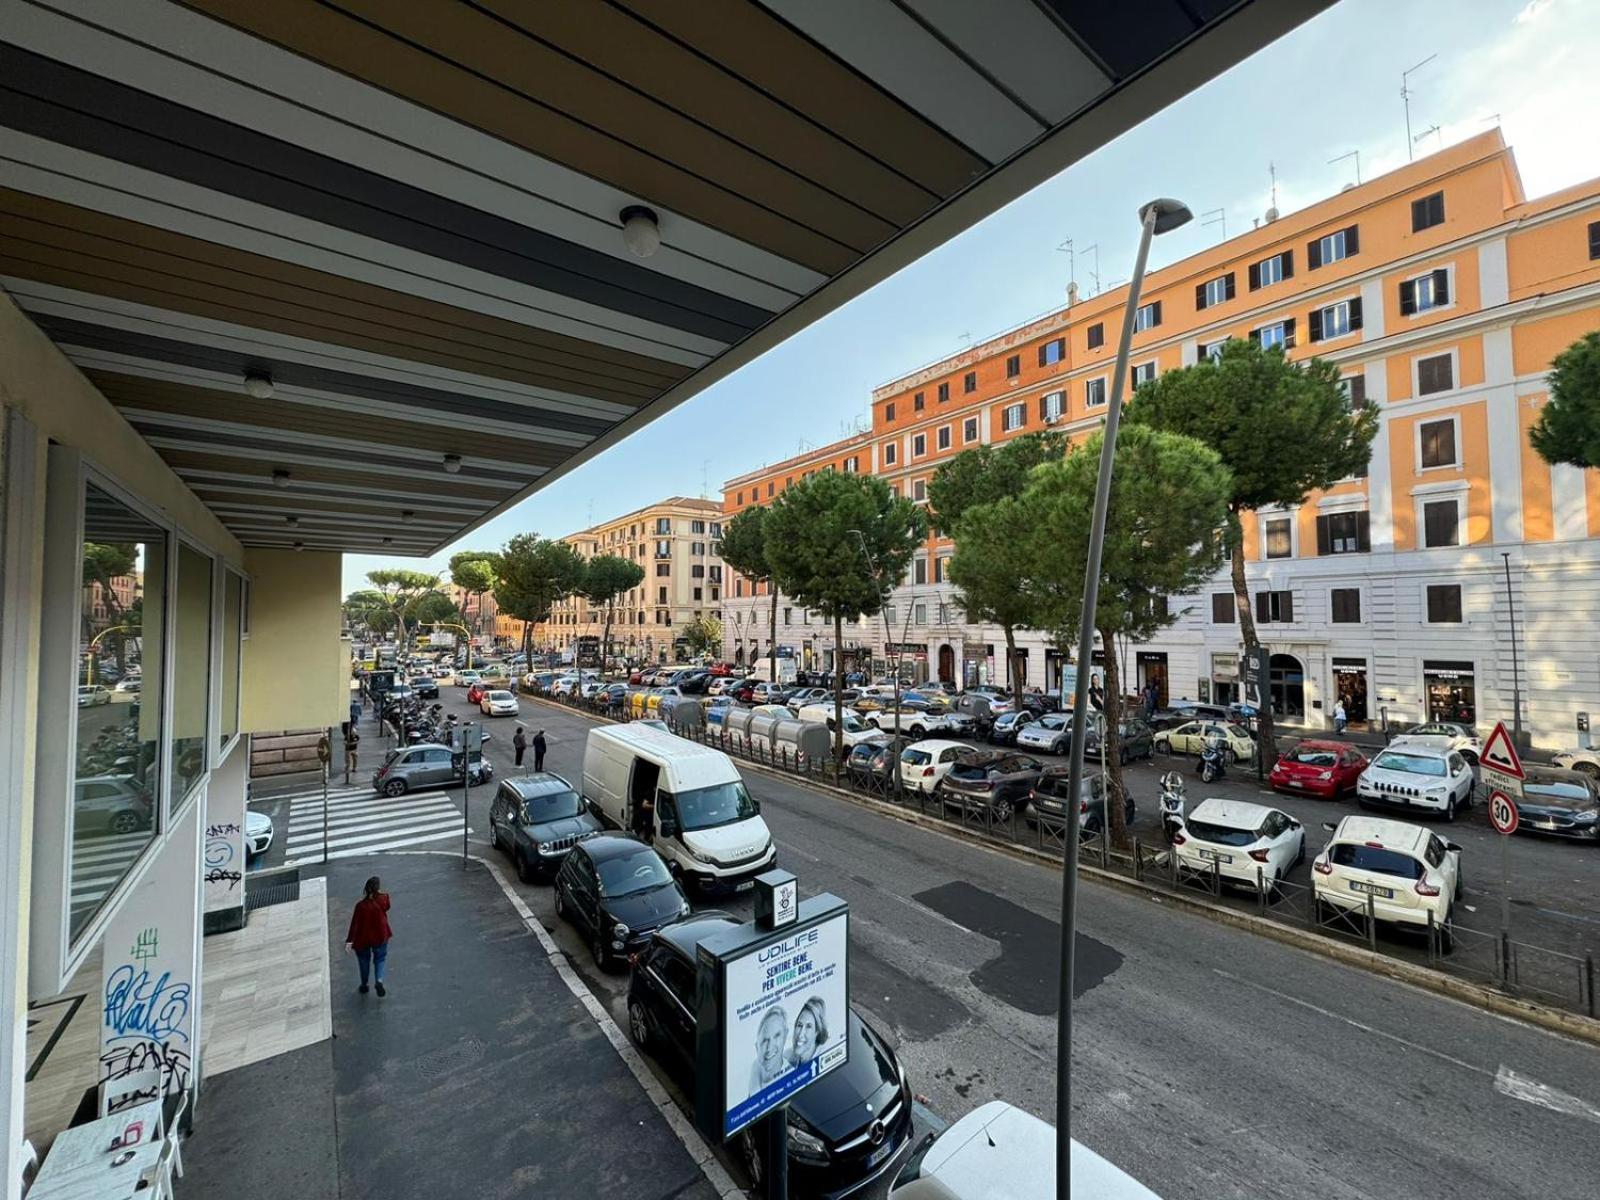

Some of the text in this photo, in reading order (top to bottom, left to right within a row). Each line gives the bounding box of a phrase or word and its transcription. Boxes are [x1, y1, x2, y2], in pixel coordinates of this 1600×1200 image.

[1494, 800, 1510, 823] 30
[758, 928, 818, 963] UDILIFE
[762, 960, 813, 992] PER VIVERE BENE
[766, 958, 791, 979] SENTIRE
[792, 951, 807, 967] BENE
